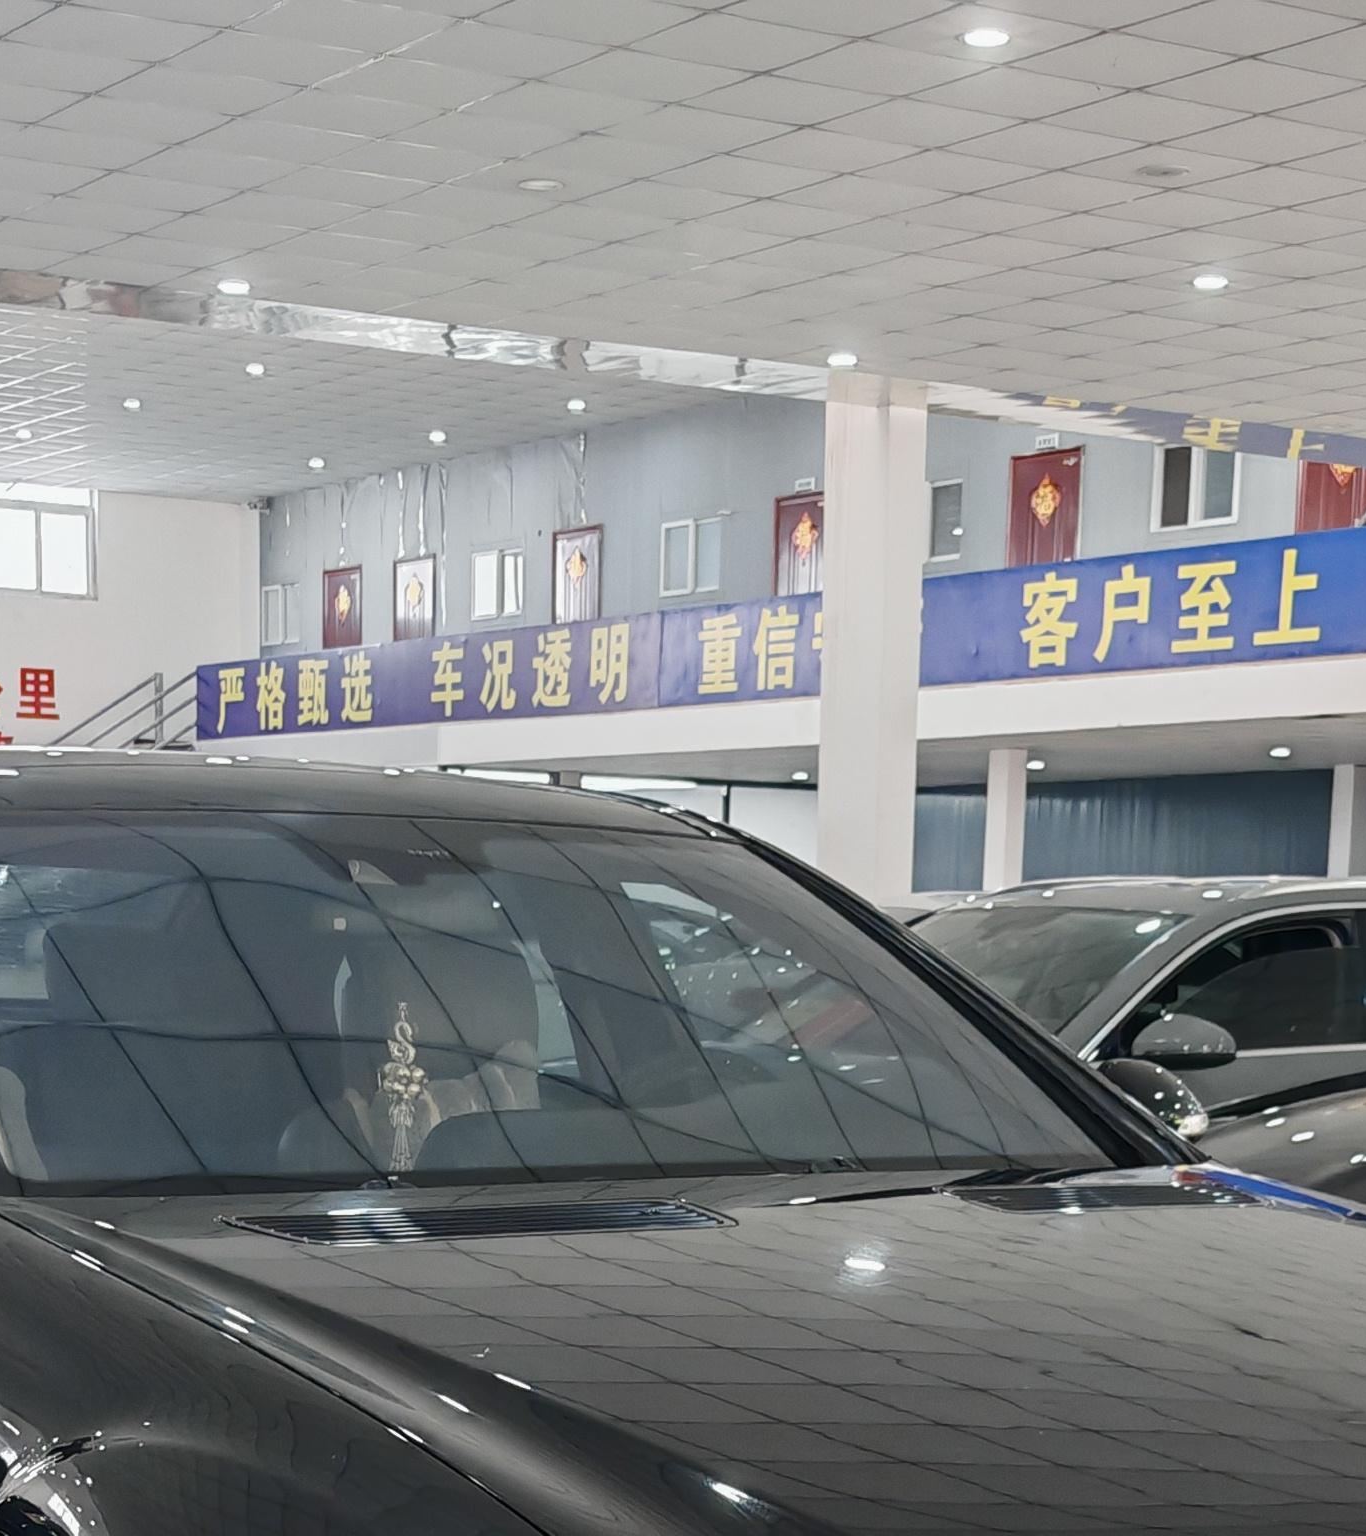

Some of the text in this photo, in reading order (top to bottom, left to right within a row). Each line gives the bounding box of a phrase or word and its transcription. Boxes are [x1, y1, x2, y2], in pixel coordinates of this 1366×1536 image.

[216, 548, 1321, 735] 严格甄选 车况透明 重信 客户至上
